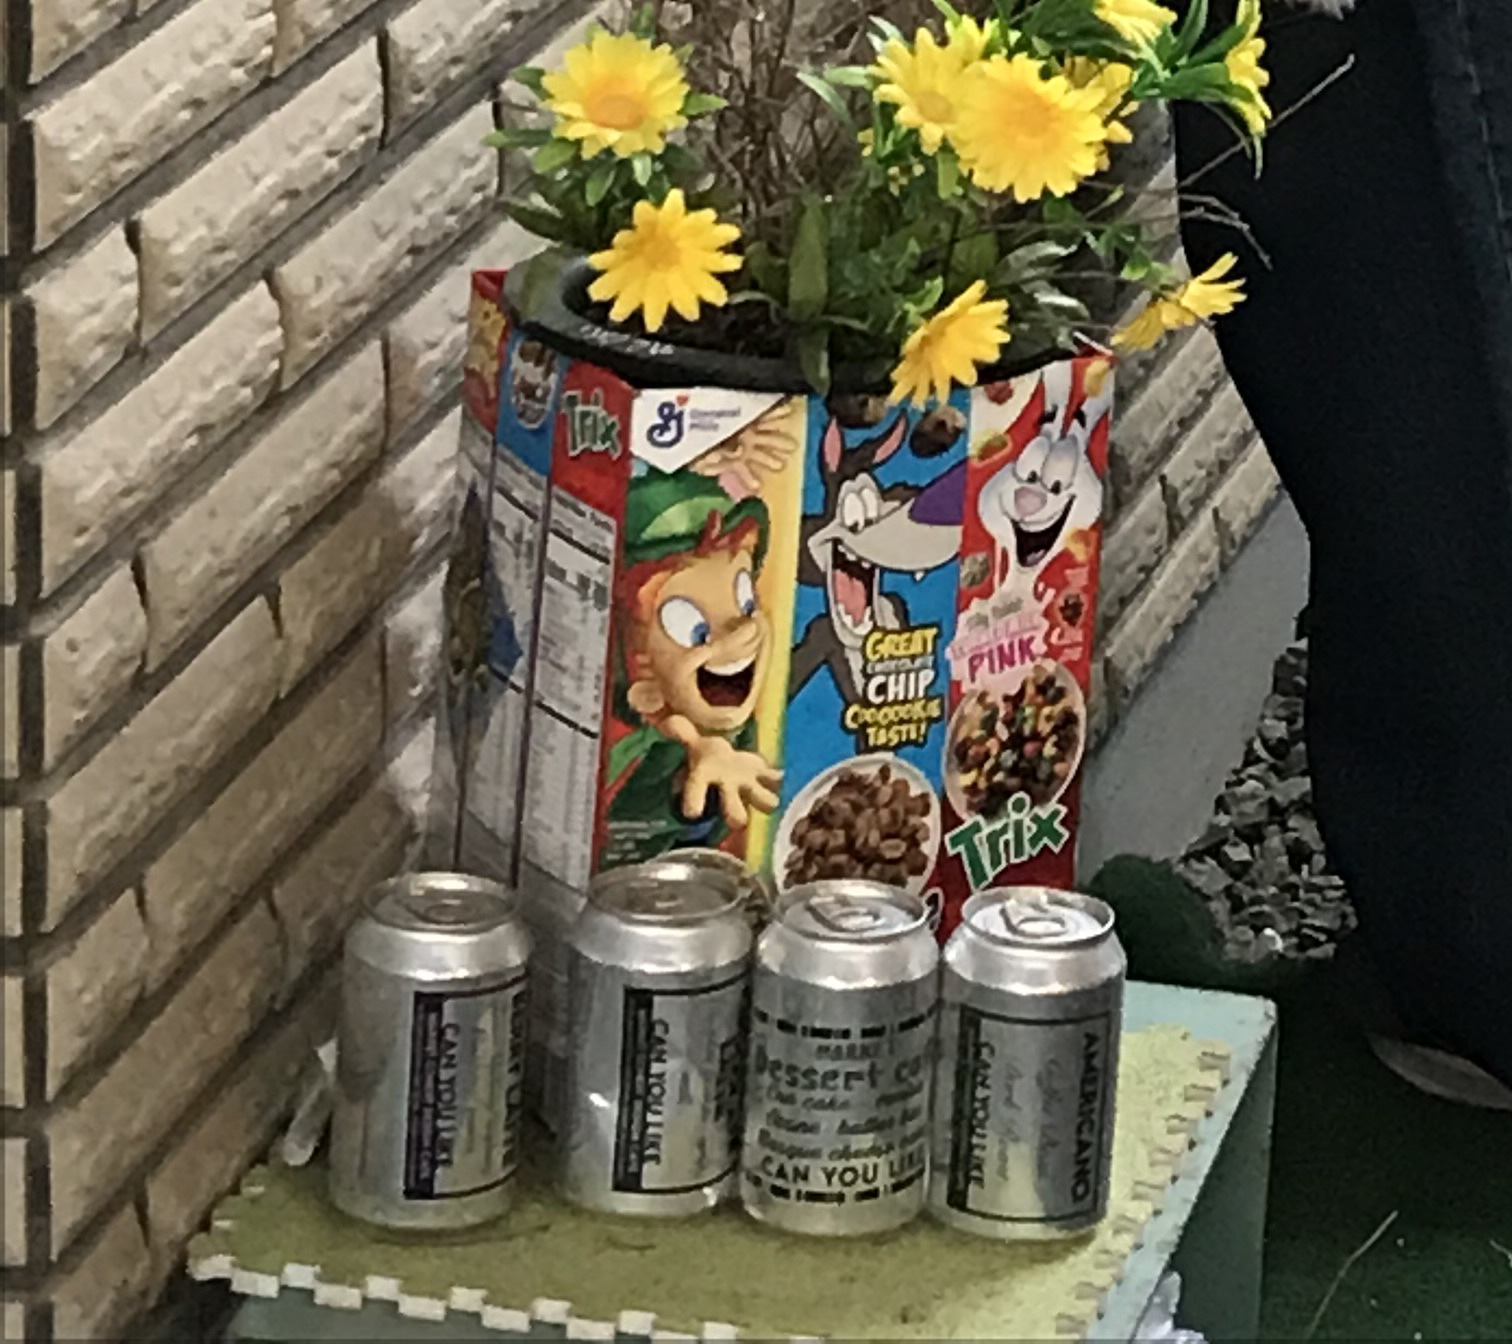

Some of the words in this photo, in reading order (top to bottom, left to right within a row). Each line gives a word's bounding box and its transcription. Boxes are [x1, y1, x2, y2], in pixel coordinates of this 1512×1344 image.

[864, 627, 939, 662] GREAT
[967, 635, 1038, 684] PINK
[866, 669, 936, 704] CHIP
[944, 790, 1070, 893] Trix
[439, 1022, 461, 1070] CAN
[648, 1018, 671, 1064] CAN
[646, 1070, 668, 1116] YOU
[1070, 1031, 1101, 1204] AMERICANO
[761, 1155, 810, 1184] CAN
[820, 1163, 879, 1187] YOU
